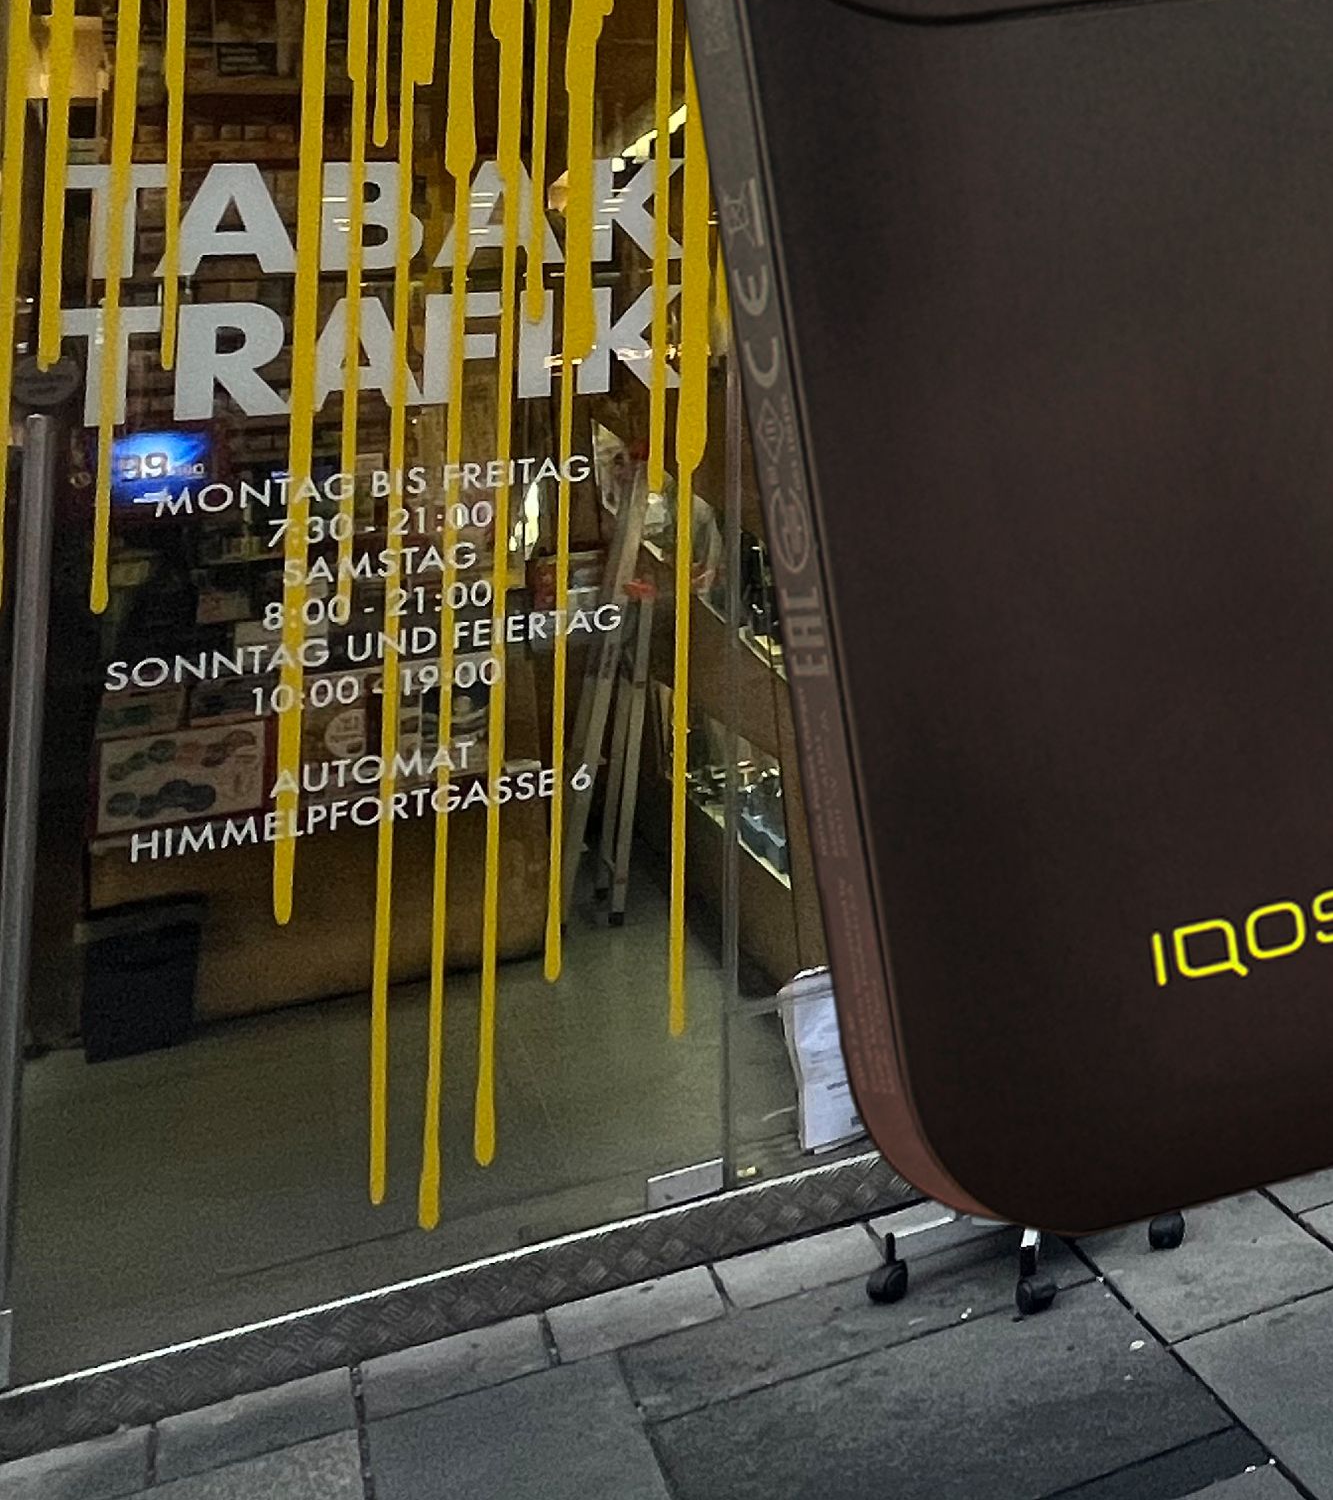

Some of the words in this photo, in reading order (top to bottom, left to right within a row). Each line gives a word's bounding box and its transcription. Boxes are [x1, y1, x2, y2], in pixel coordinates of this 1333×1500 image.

[62, 158, 686, 279] TABAK
[60, 283, 686, 427] TRAFIK
[155, 473, 355, 518] MONTAG
[371, 464, 428, 498] BIS
[443, 453, 592, 492] FREITAG
[388, 500, 494, 537] 21:00
[282, 541, 477, 586] SAMSTAG
[262, 592, 350, 630] 8:00
[386, 579, 493, 617] 21:00
[104, 637, 331, 693] SONNTAG
[346, 625, 438, 664] UND
[452, 603, 623, 651] FEIERTAG
[251, 676, 360, 717] 10:00
[269, 740, 476, 799] AUTOMAT
[129, 767, 557, 864] HIMMELPFORTGASSE
[569, 762, 593, 794] 6
